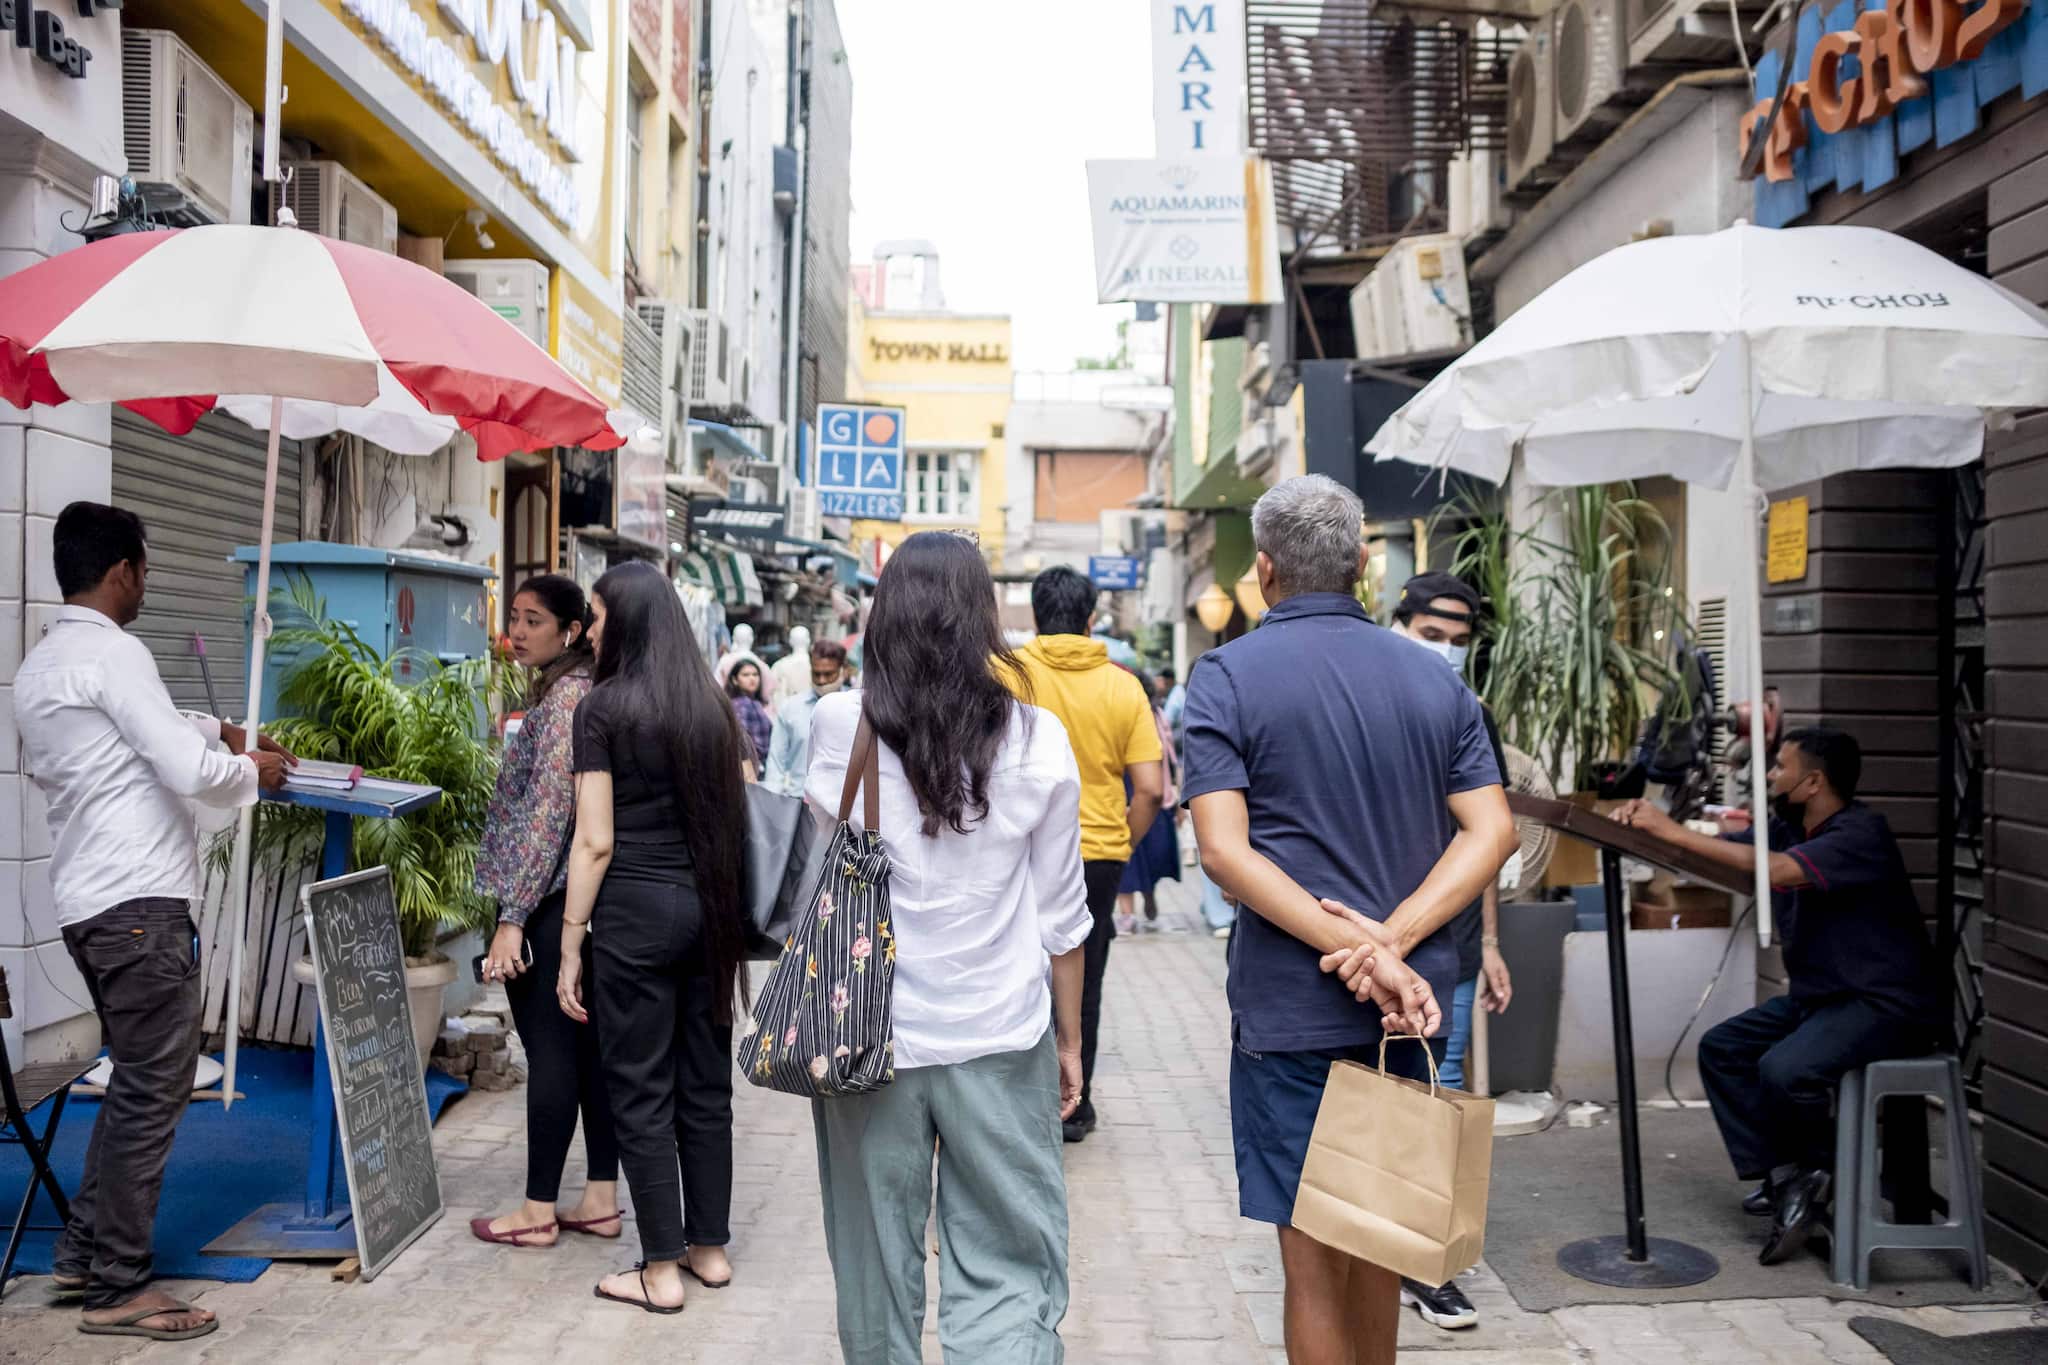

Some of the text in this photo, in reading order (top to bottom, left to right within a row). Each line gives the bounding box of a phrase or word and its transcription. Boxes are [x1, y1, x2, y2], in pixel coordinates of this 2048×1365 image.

[34, 10, 92, 78] Bar
[870, 336, 1008, 363] TOWN HALL
[819, 494, 901, 517] SIZZLERS
